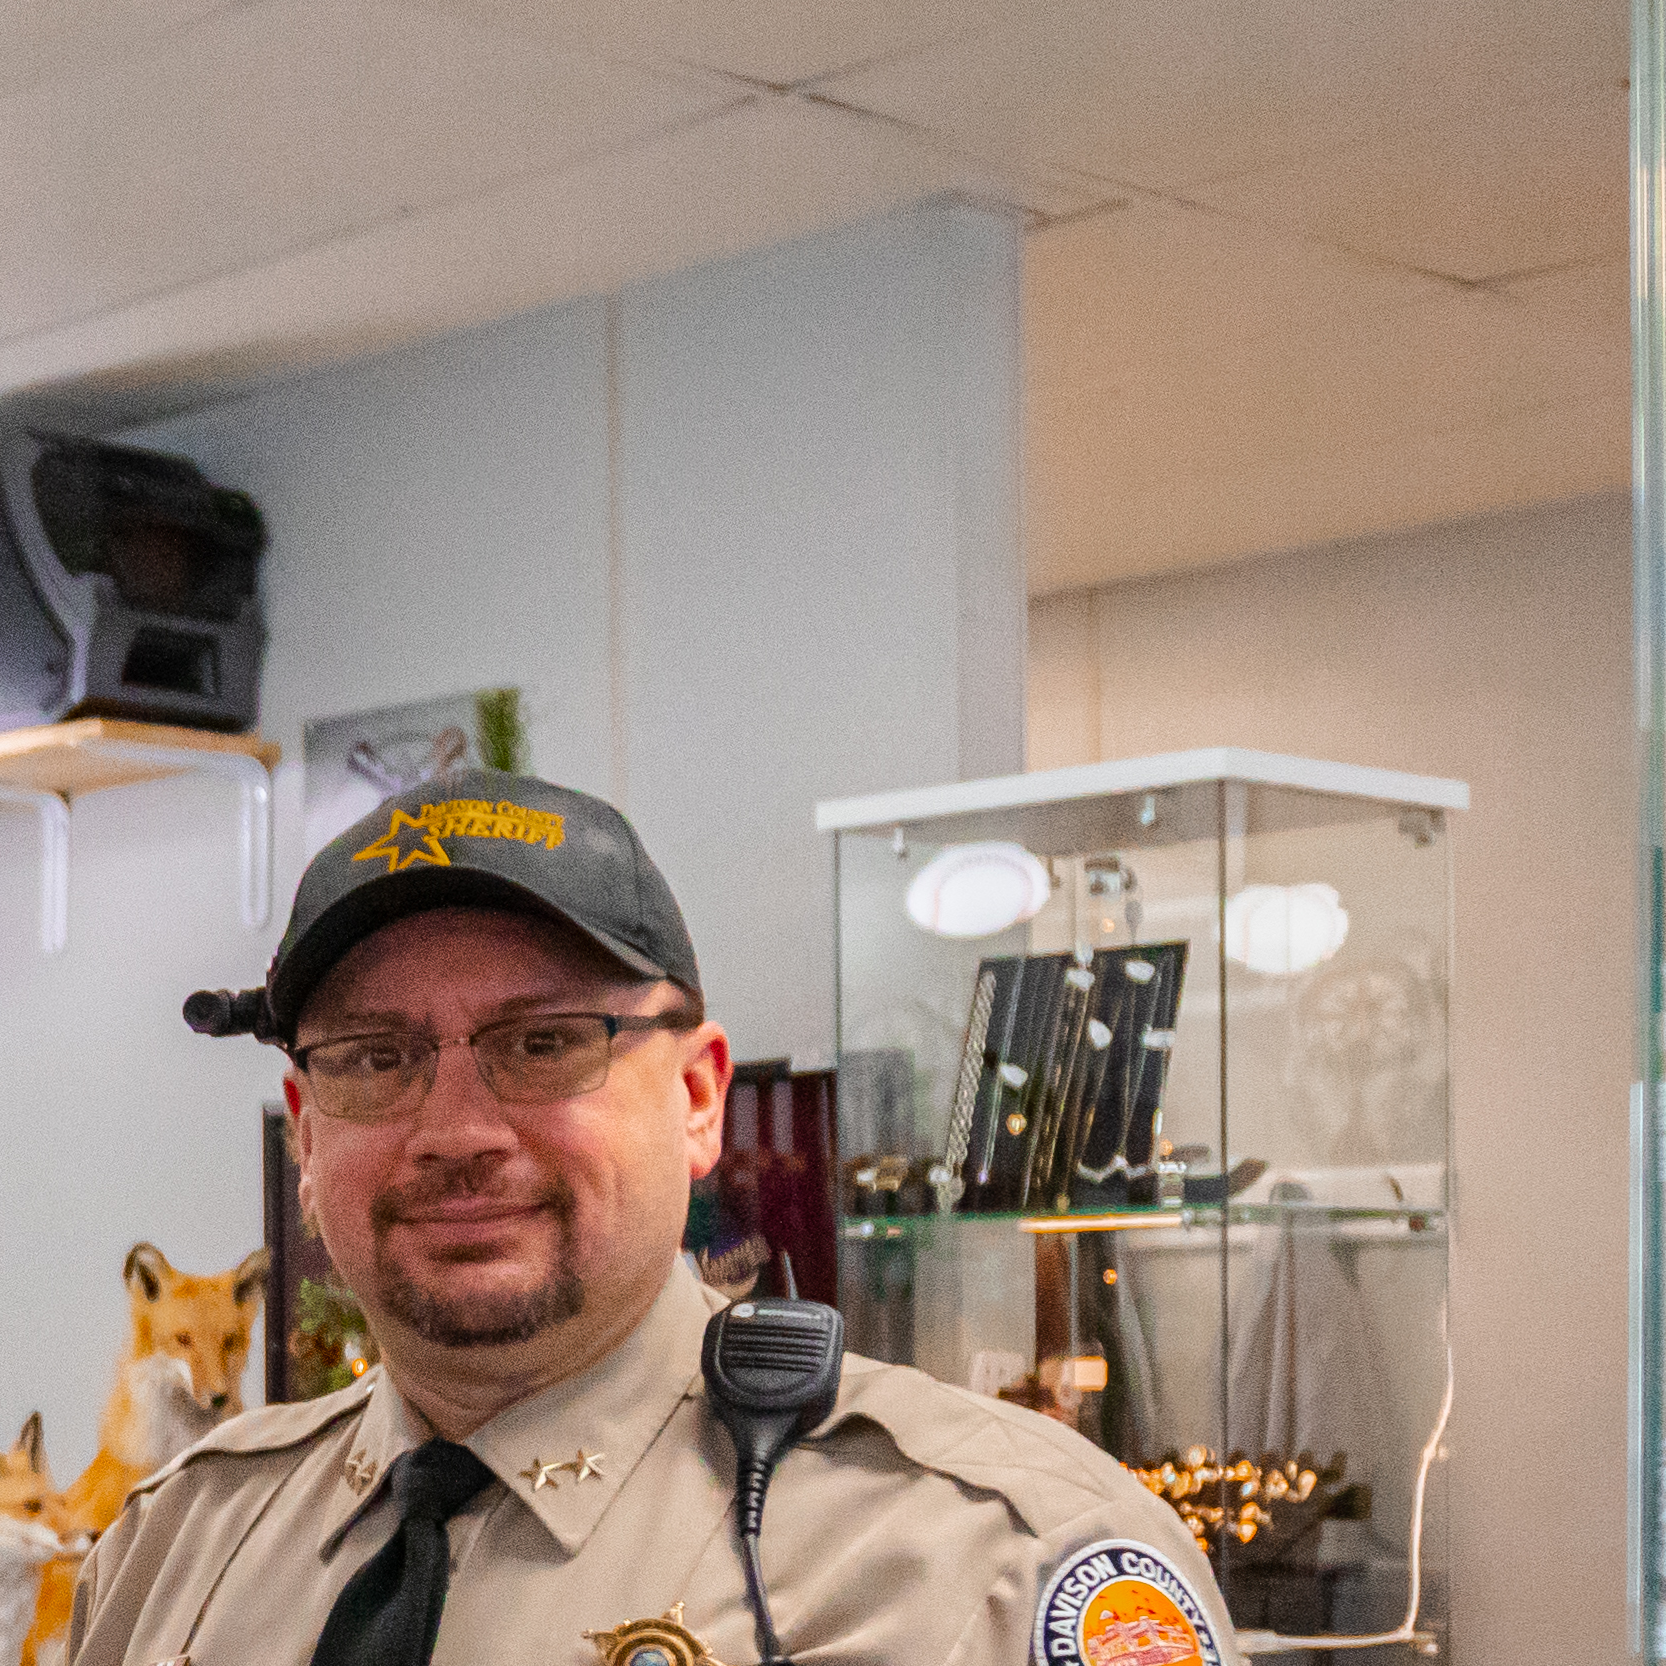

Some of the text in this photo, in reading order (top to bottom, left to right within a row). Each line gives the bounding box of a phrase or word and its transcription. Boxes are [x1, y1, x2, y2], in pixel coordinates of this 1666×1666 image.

[423, 816, 565, 850] SHERIFF
[1050, 1552, 1207, 1658] DAVISON COUNTY
